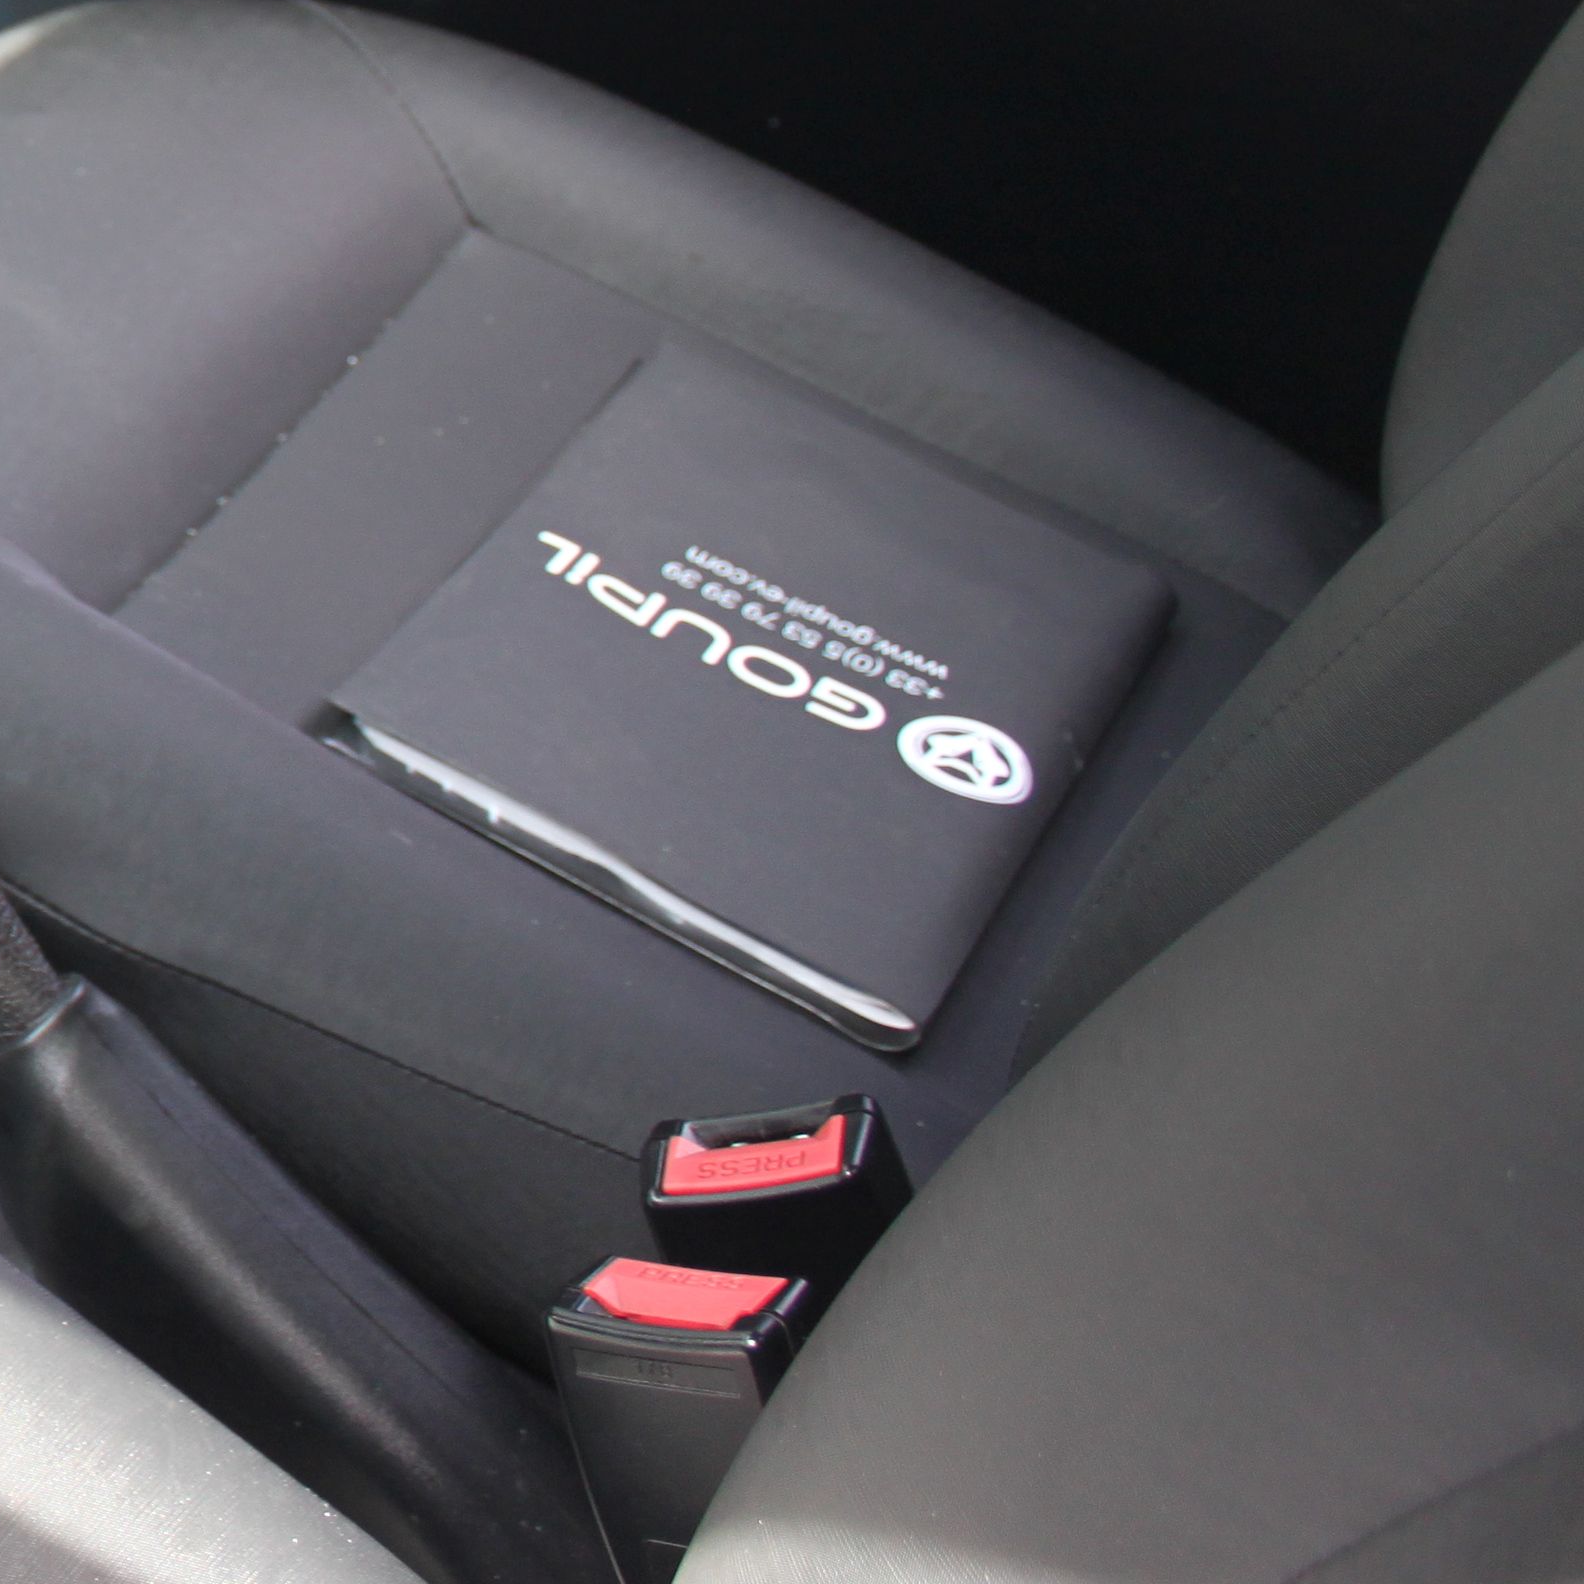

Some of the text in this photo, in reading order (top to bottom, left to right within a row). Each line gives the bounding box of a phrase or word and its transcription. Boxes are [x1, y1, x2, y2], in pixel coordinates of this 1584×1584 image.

[684, 545, 948, 681] www.goupil-ev.com
[740, 601, 781, 631] 79
[537, 530, 886, 731] GOUPIL
[781, 620, 823, 649] 53
[821, 639, 885, 677] (0)5
[884, 668, 945, 700] +33
[698, 1150, 806, 1180] PRESS
[638, 1266, 745, 1289] PRESS
